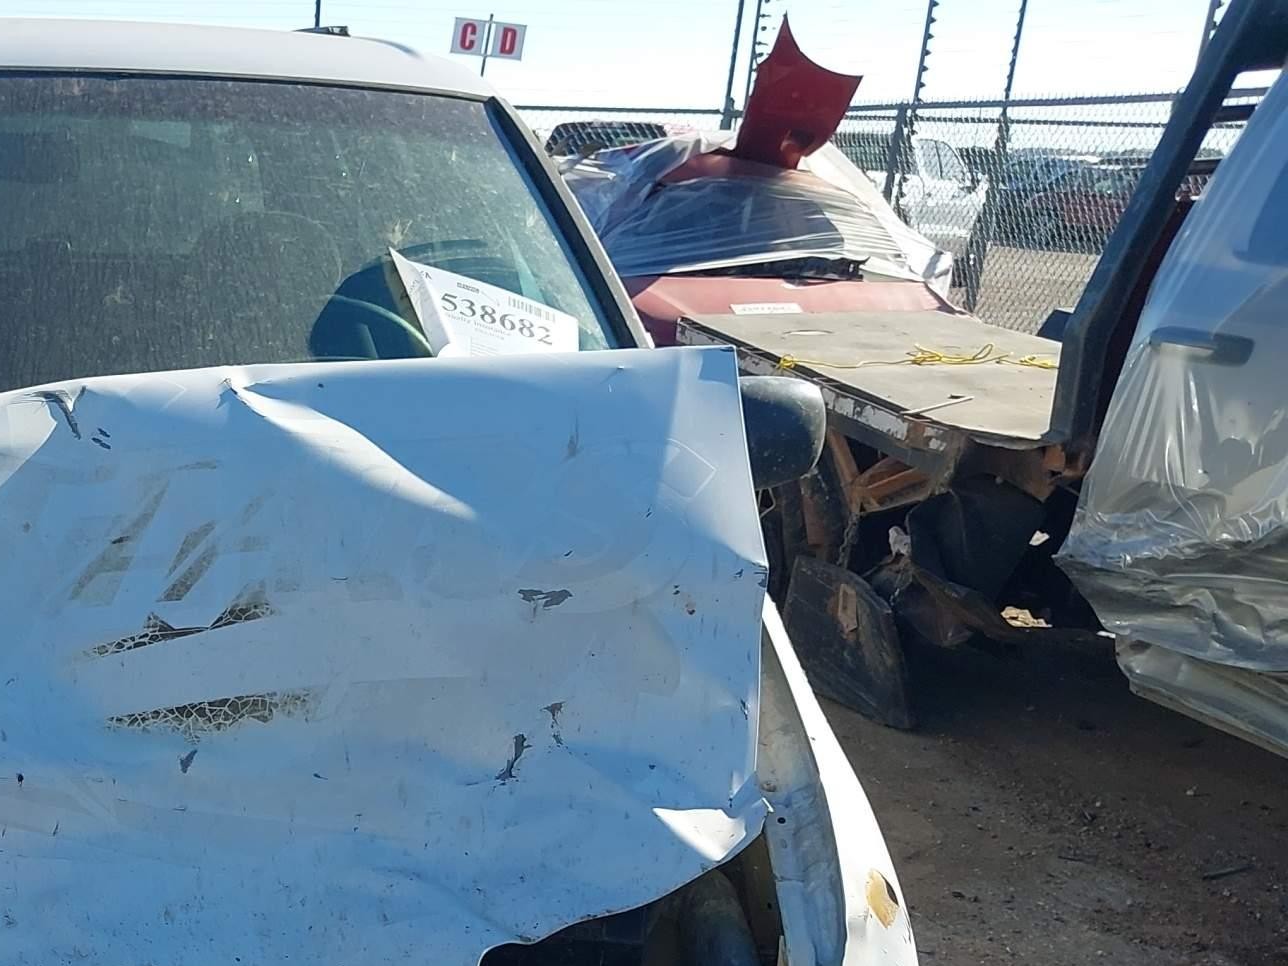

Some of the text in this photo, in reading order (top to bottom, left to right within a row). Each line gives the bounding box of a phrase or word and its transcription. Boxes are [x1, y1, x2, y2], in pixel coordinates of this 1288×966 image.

[459, 22, 517, 55] C D
[441, 293, 553, 346] 538682
